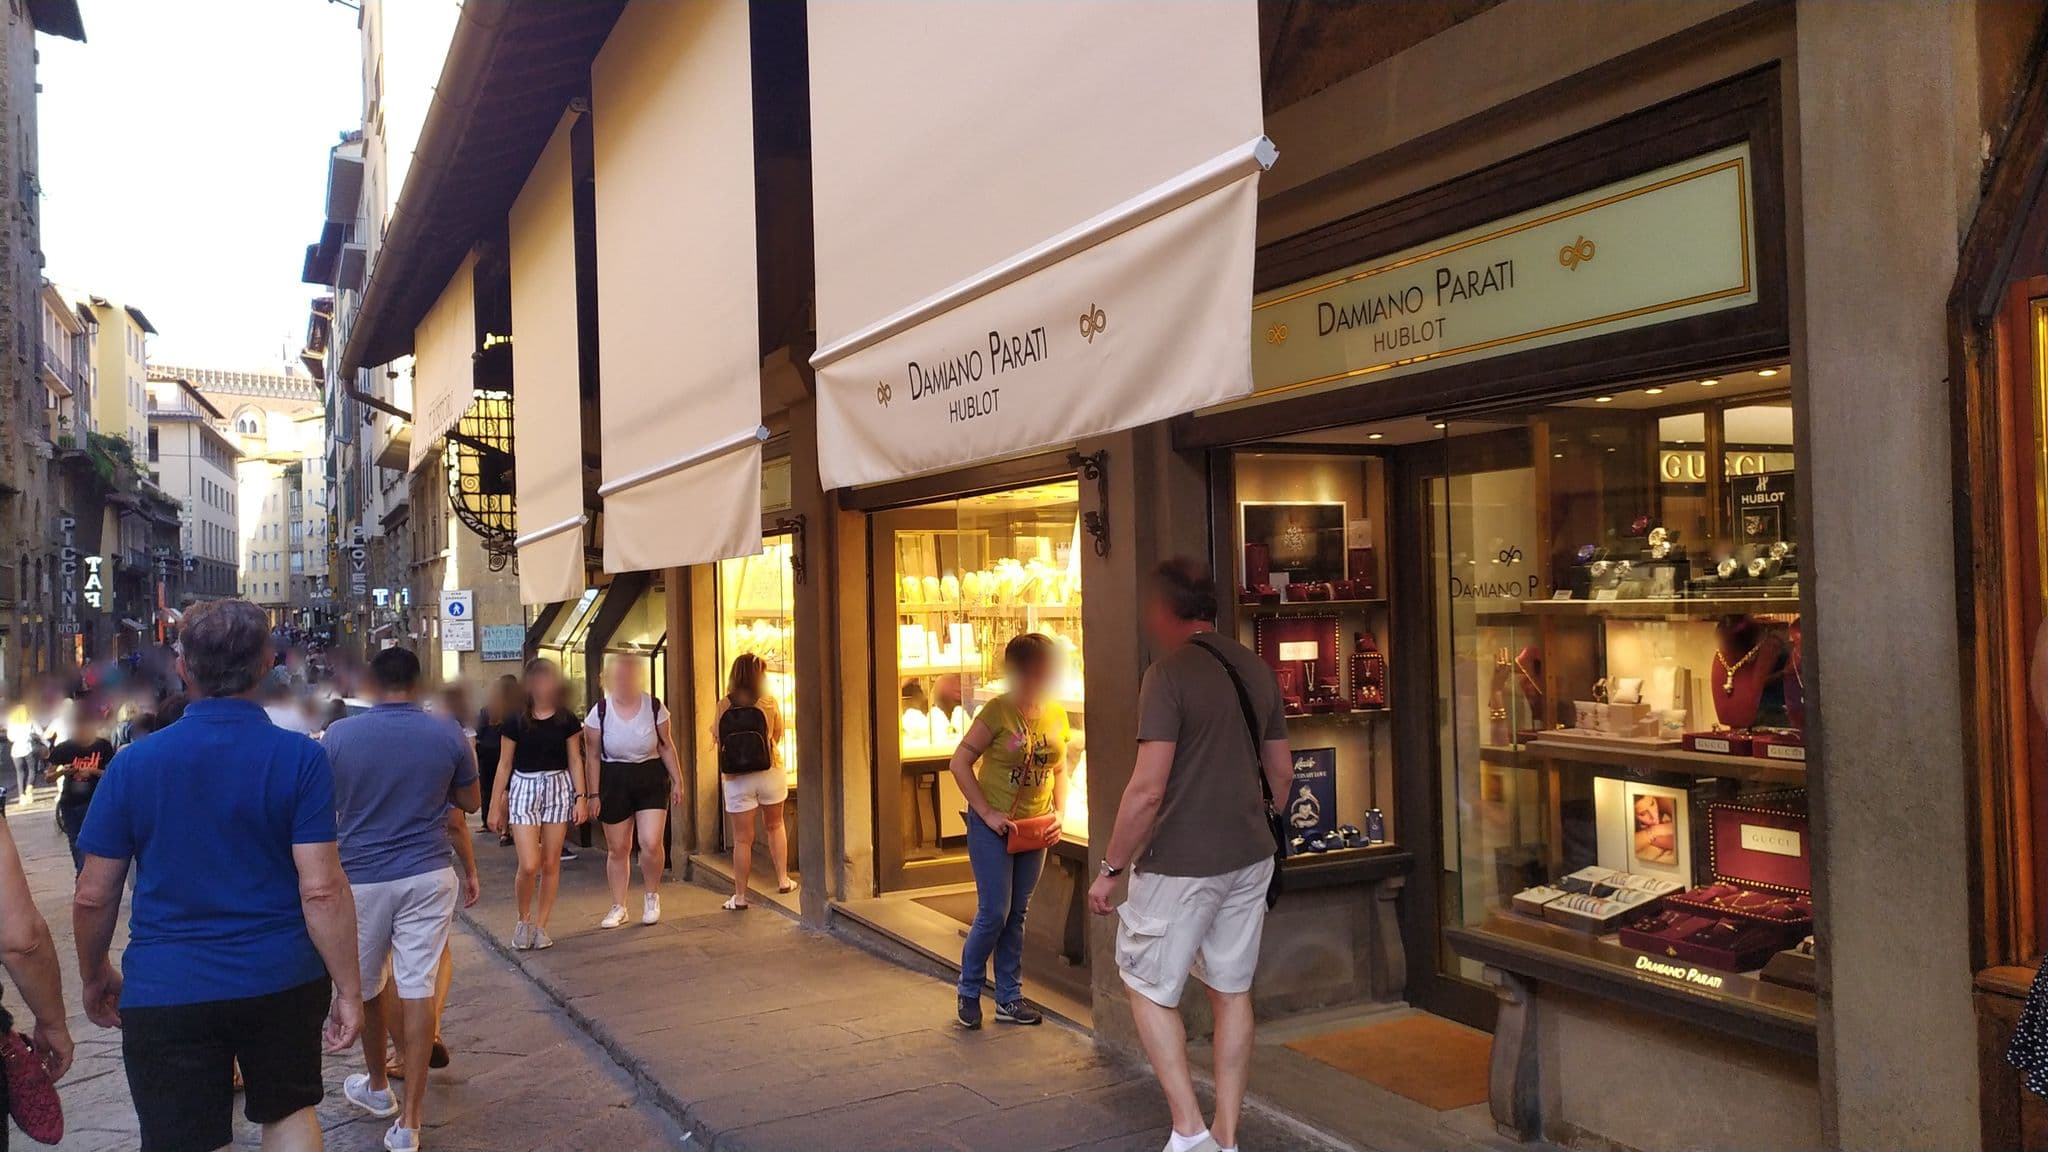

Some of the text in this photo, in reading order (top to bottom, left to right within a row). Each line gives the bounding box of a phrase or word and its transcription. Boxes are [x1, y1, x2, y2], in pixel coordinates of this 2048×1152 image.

[1317, 260, 1515, 337] DAMIANO PARATI
[1373, 317, 1446, 353] HUBLOT
[908, 326, 1049, 401] DAMIANO PARATI
[949, 389, 1000, 424] HUBLOT
[1741, 491, 1786, 505] HUBLOT
[60, 517, 77, 621] PICCINI
[351, 525, 367, 596] GLOVES
[1752, 834, 1791, 847] GUCCI
[1635, 955, 1686, 979] DAMIANO
